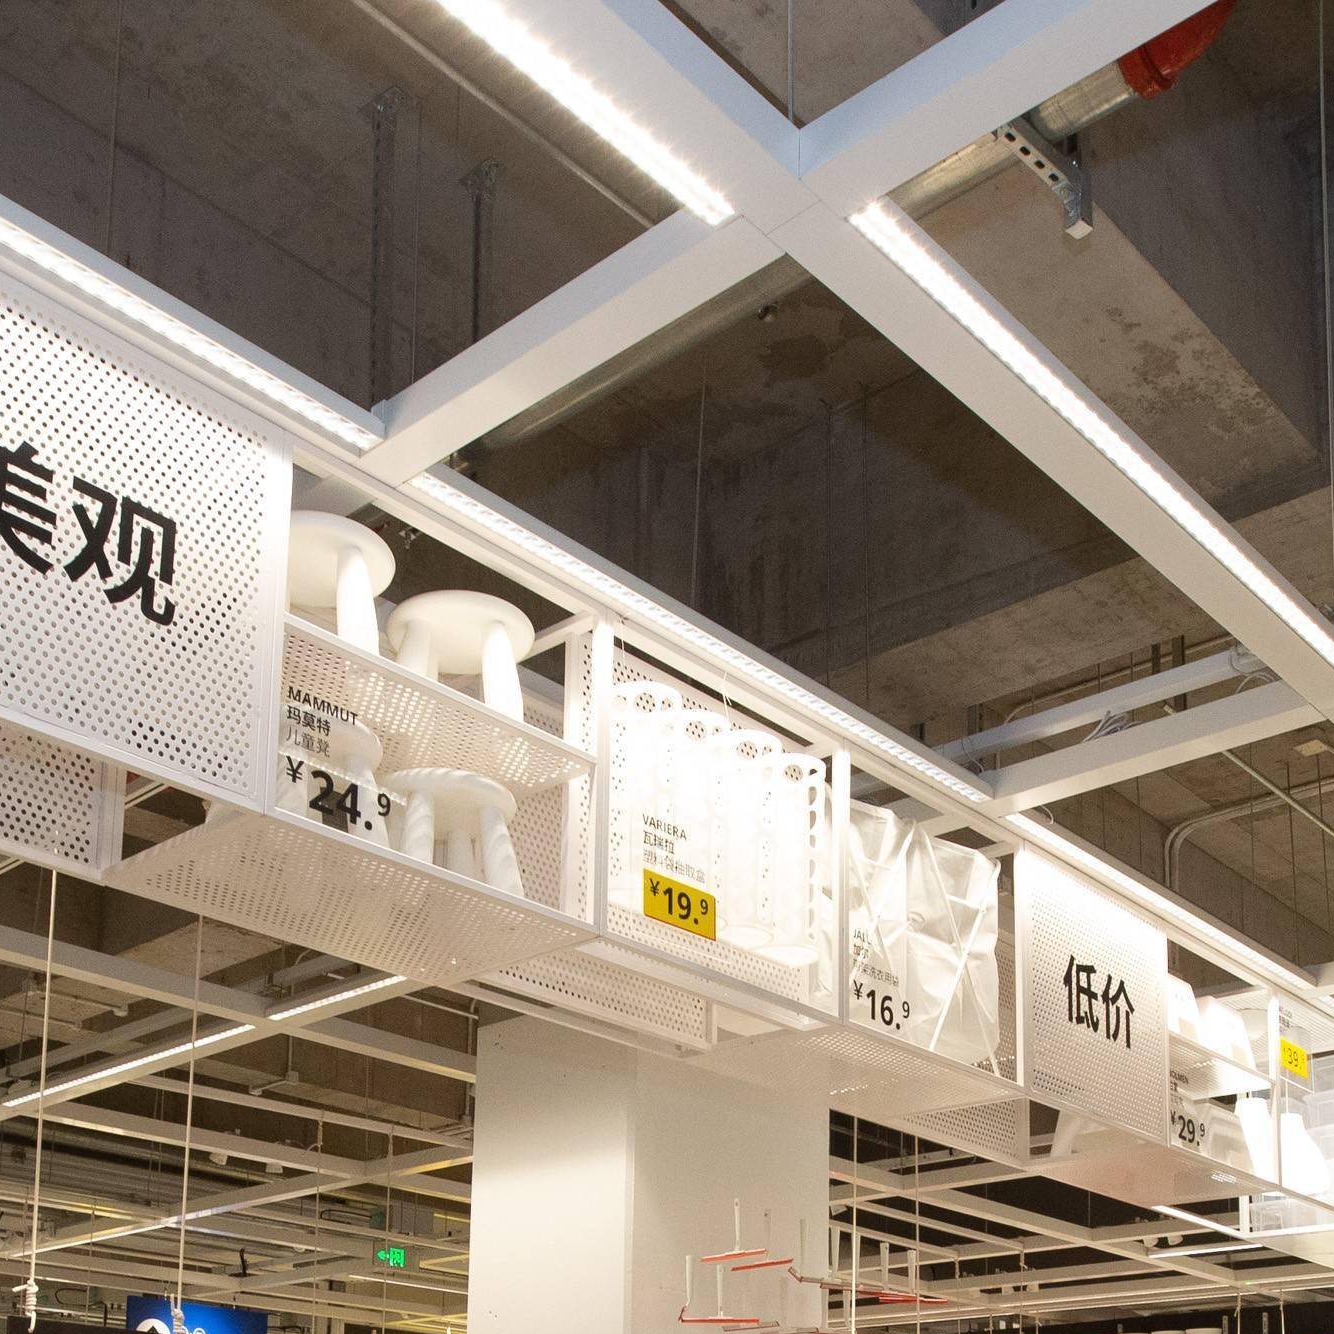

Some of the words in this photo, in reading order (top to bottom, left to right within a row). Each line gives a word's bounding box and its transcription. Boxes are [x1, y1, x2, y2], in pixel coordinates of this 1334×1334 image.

[286, 705, 331, 737] 玛莫特
[288, 686, 358, 725] MAMMUT
[285, 725, 331, 758] 儿童凳
[642, 813, 687, 840] VARIERA
[1064, 954, 1135, 1049] 低价
